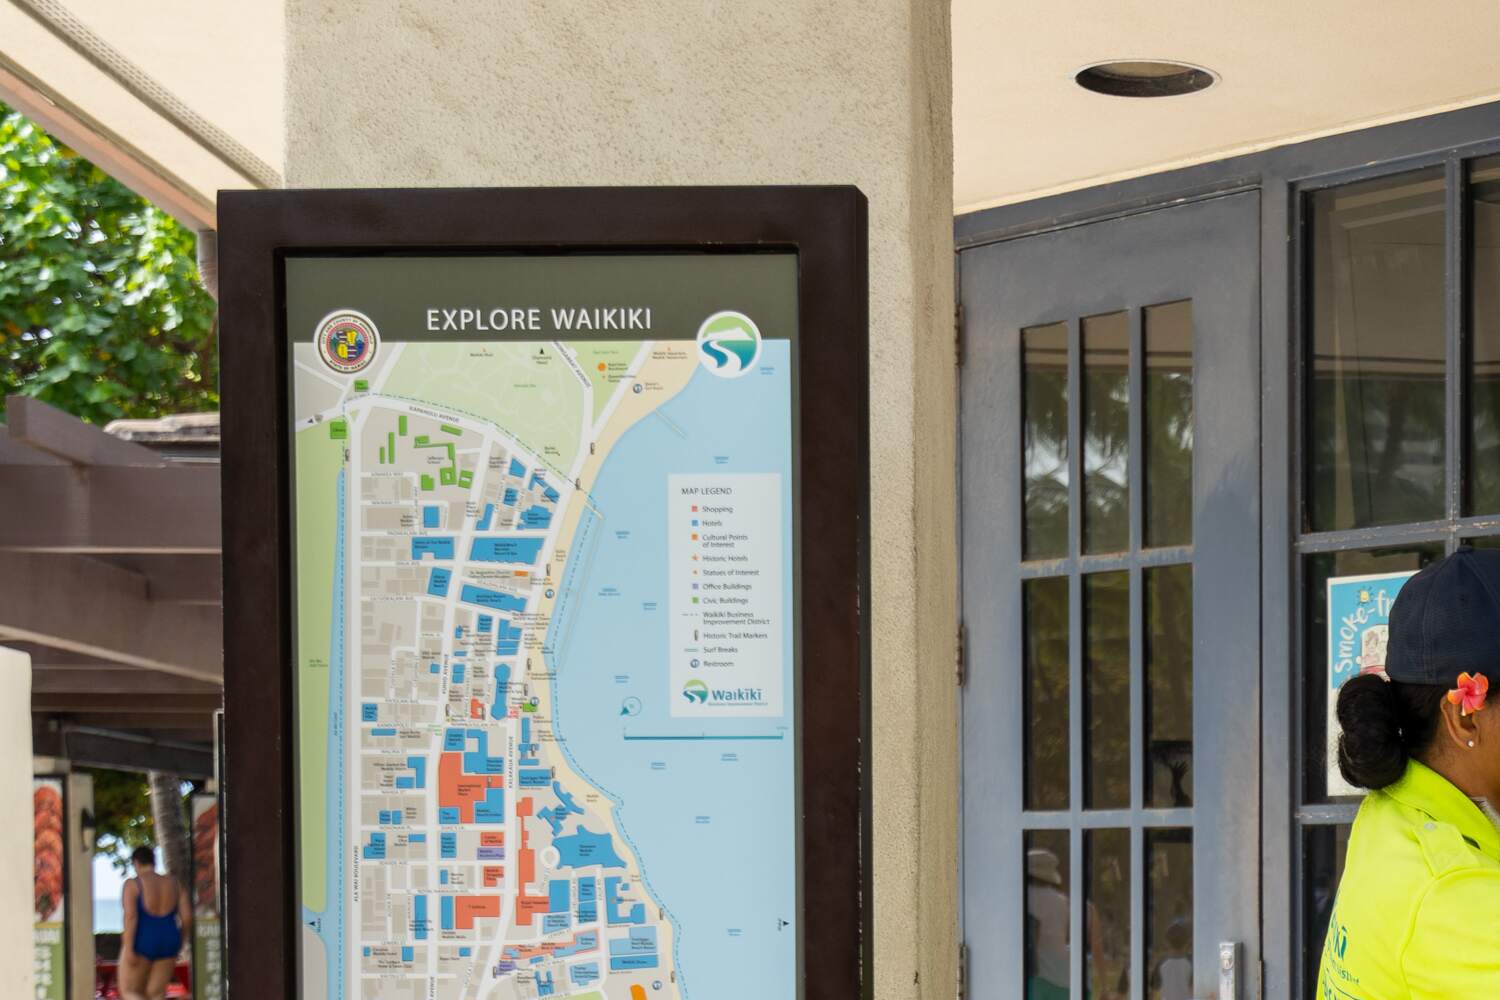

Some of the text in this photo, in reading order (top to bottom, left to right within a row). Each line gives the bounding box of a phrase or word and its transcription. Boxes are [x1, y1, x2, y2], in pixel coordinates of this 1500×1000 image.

[426, 308, 652, 331] EXPLORE WAIKIKI
[681, 487, 733, 496] MAP LEGEND
[702, 505, 734, 515] Shopping
[702, 519, 723, 528] Hotels
[702, 533, 749, 542] Cultural Points
[702, 541, 735, 549] of Interest
[702, 554, 749, 563] Historic Hotels
[702, 568, 760, 577] Statues of Interest
[702, 582, 752, 592] Office Buildings
[702, 596, 749, 606] Civic Buildings
[726, 610, 754, 619] Business
[703, 618, 770, 627] Improvement District
[1334, 589, 1397, 673] Smoke-fr
[703, 631, 768, 641] Historic Trail Markers
[703, 646, 738, 655] Surf Breaks
[703, 660, 734, 669] Restroom
